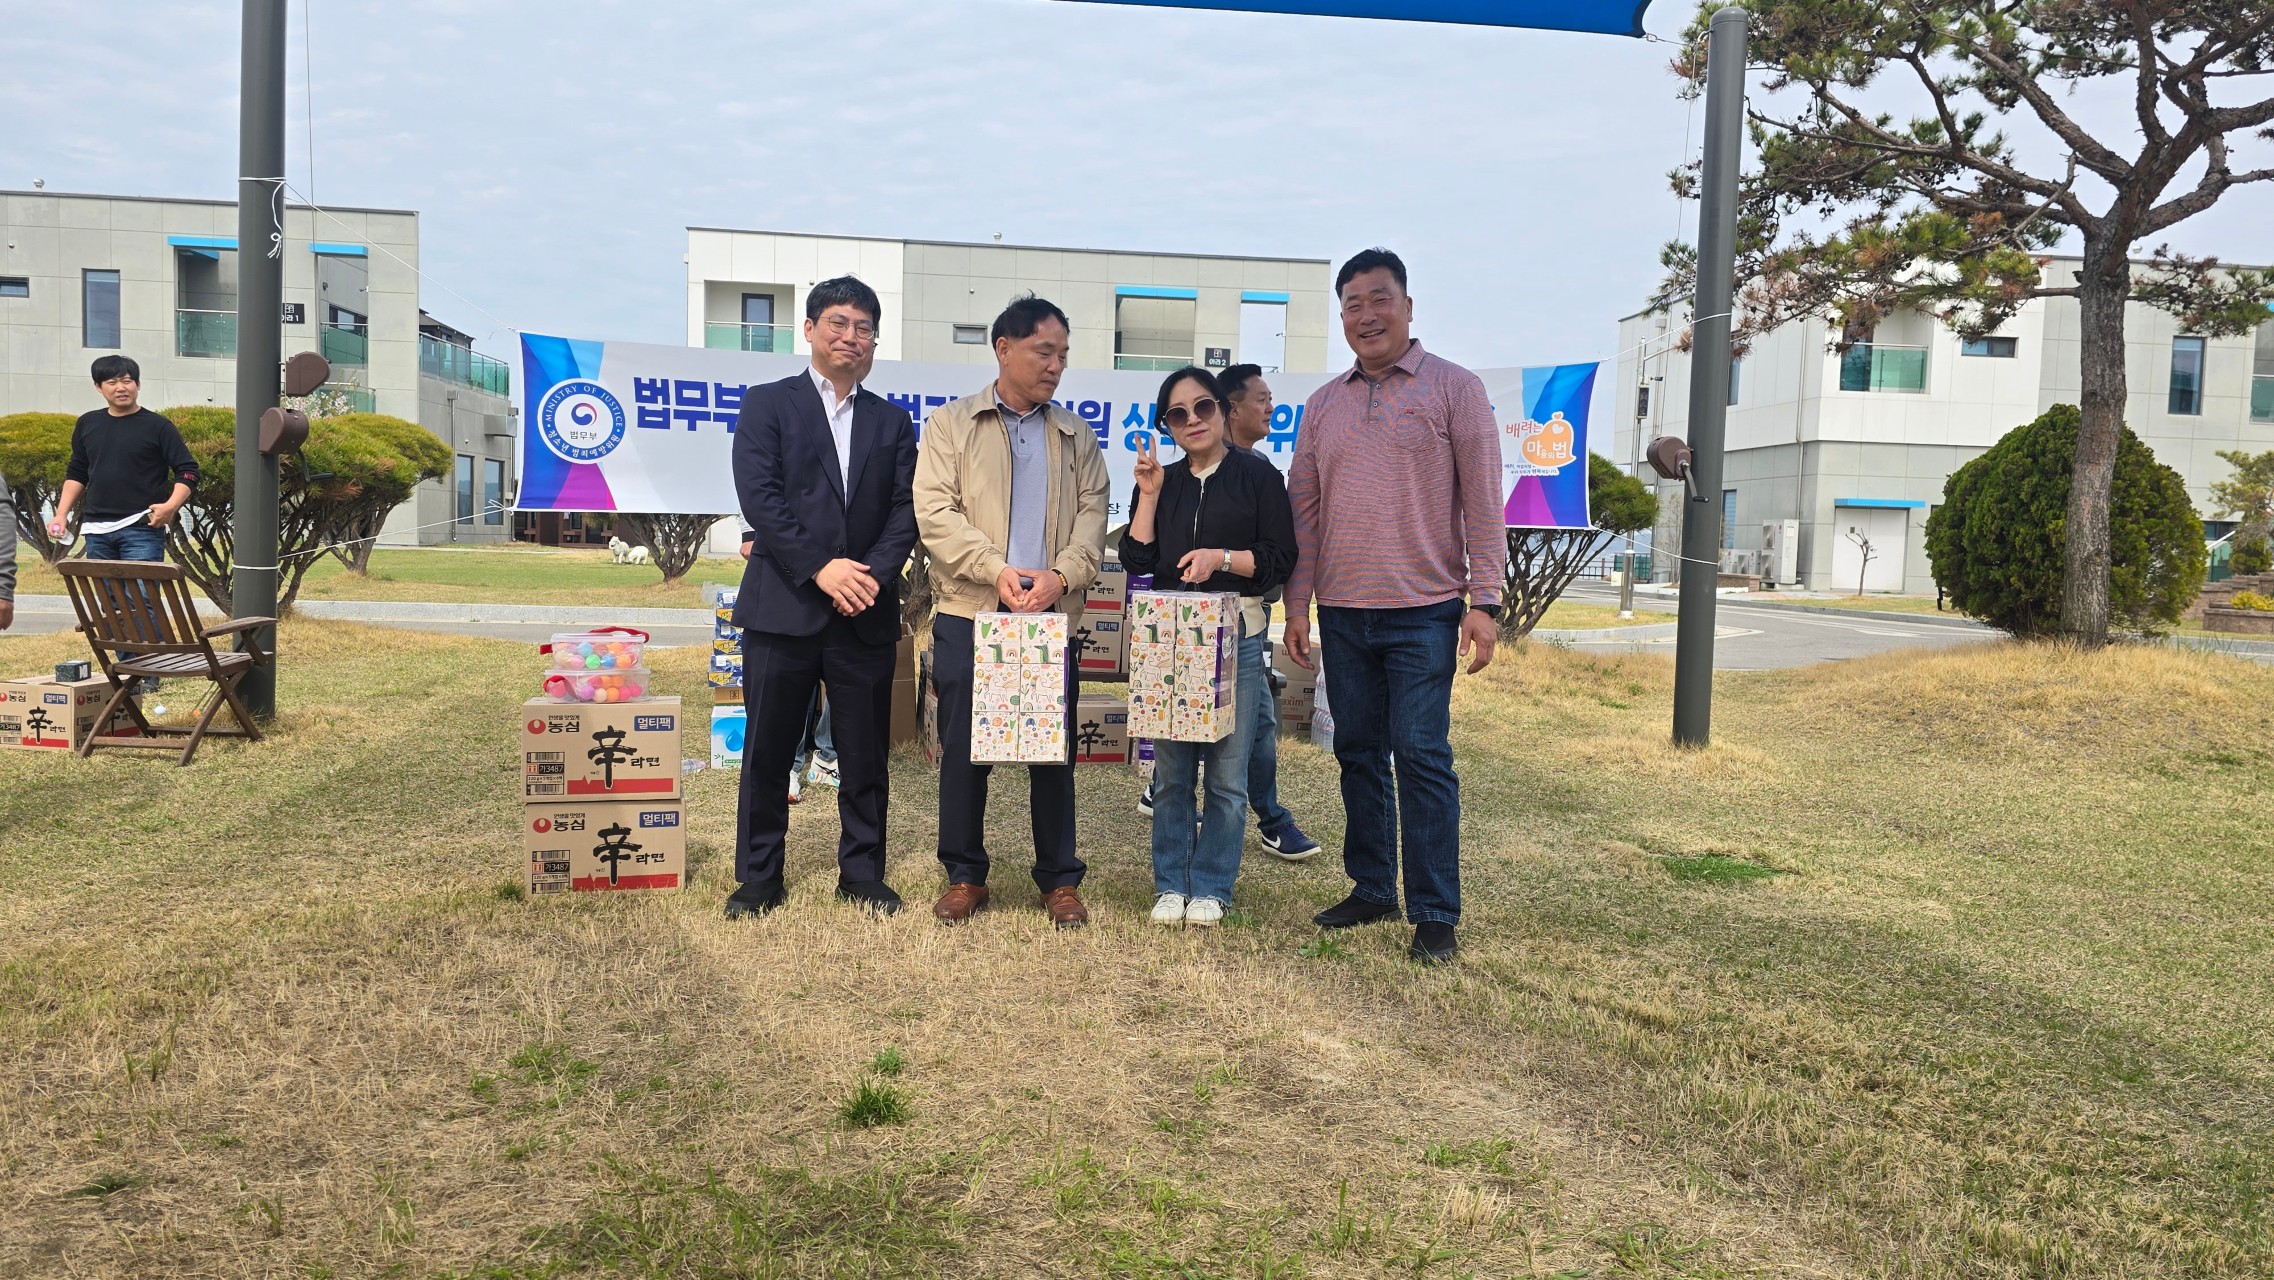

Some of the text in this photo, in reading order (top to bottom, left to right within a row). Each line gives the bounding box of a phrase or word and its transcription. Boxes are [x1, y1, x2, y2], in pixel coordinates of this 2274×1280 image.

[546, 385, 623, 427] MINISTRY OF JUSTICE
[633, 376, 748, 434] 법무부
[570, 431, 597, 441] 법무부
[1506, 421, 1543, 438] 배려는
[548, 429, 570, 452] 청소년
[1552, 441, 1568, 459] 법
[1097, 587, 1115, 595] 라면
[1092, 646, 1110, 654] 라면
[8, 694, 27, 702] 농심
[27, 706, 53, 743] 辛
[547, 721, 580, 733] 농심
[637, 717, 671, 729] 멀티팩
[1077, 719, 1105, 759] 辛
[1101, 739, 1119, 747] 라면
[587, 725, 638, 788] 辛
[630, 756, 660, 768] 라면
[539, 764, 563, 773] 가3487
[553, 819, 586, 832] 농심
[642, 812, 676, 826] 멀티팩
[592, 822, 643, 885] 辛
[635, 852, 666, 865] 라면
[545, 862, 569, 872] 가3487
